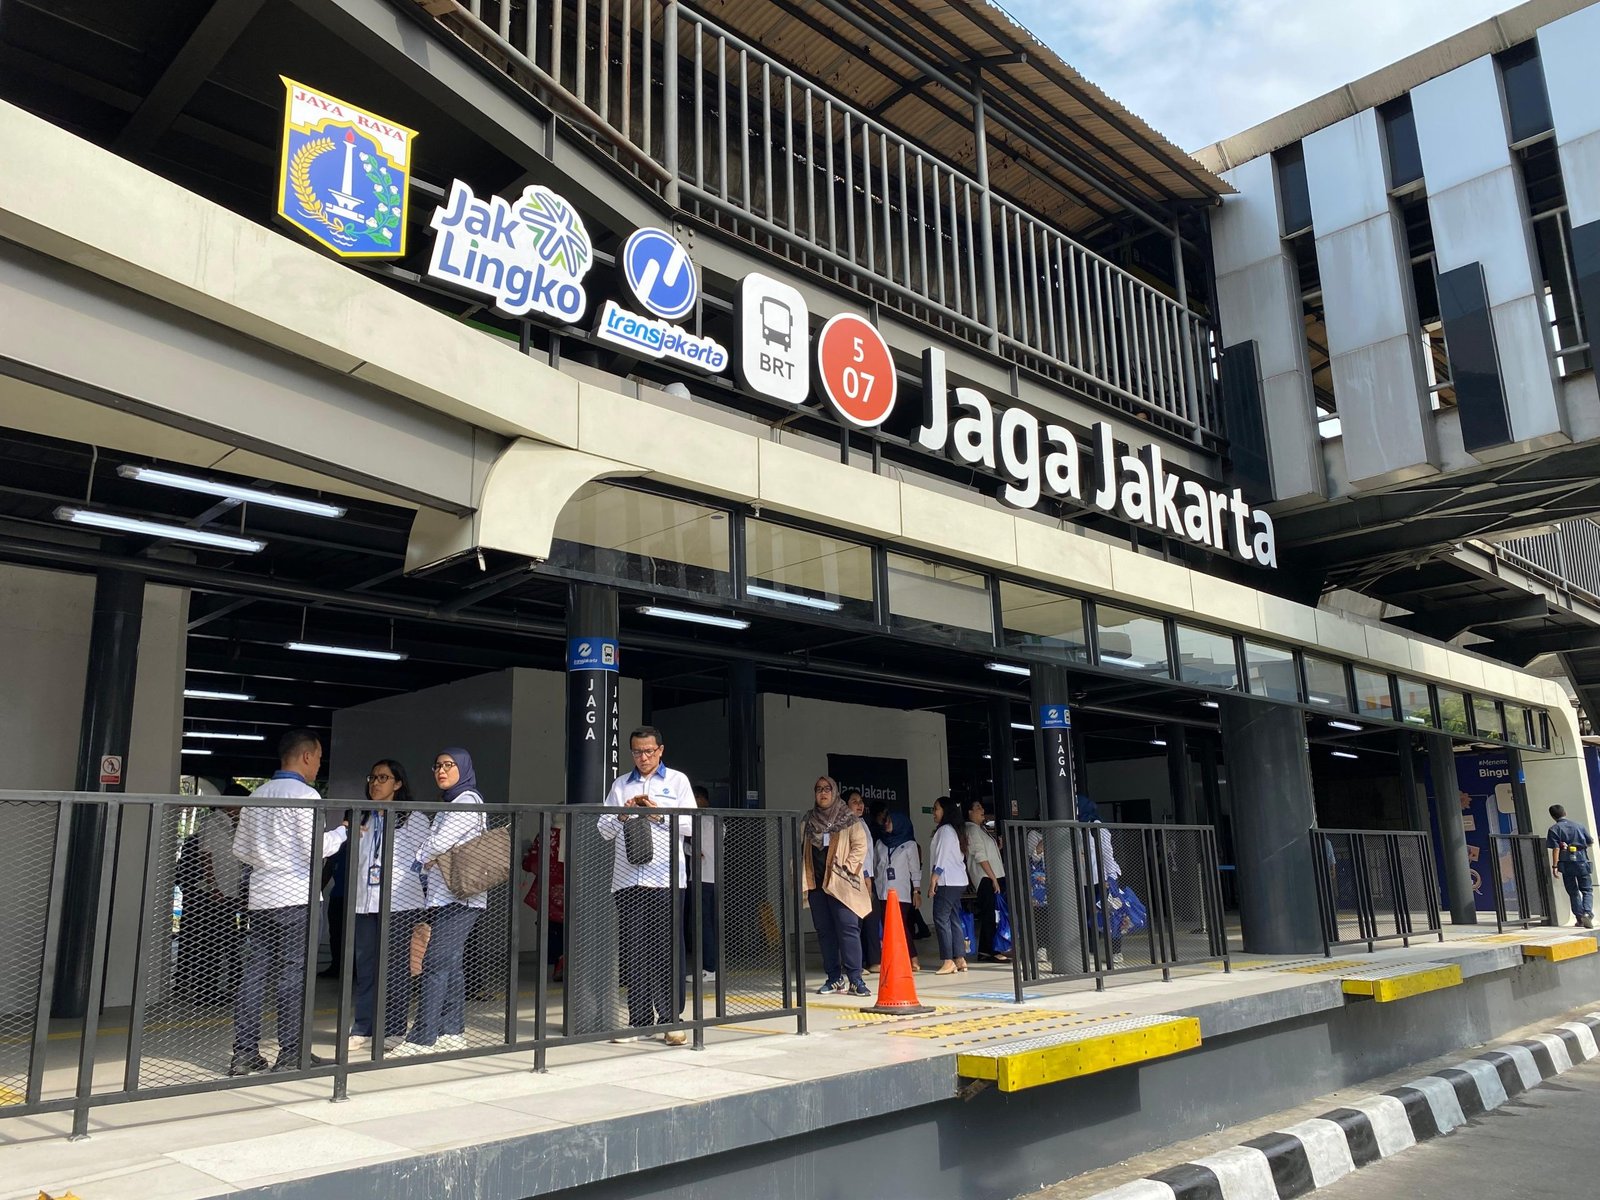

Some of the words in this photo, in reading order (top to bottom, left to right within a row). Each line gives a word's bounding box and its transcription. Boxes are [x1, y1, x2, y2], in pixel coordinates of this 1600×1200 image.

[295, 91, 344, 118] JAYA
[357, 115, 404, 142] RAYA
[441, 188, 520, 249] Jak
[438, 231, 581, 315] Lingko
[606, 308, 724, 367] transjakarta
[853, 337, 864, 363] 5
[760, 352, 795, 380] BRT
[842, 366, 875, 403] 07
[918, 346, 1082, 508] Jaga
[1096, 421, 1277, 569] Jakarta
[585, 678, 596, 740] JAGA
[1057, 733, 1066, 776] JAGA
[861, 783, 897, 801] Jakarta
